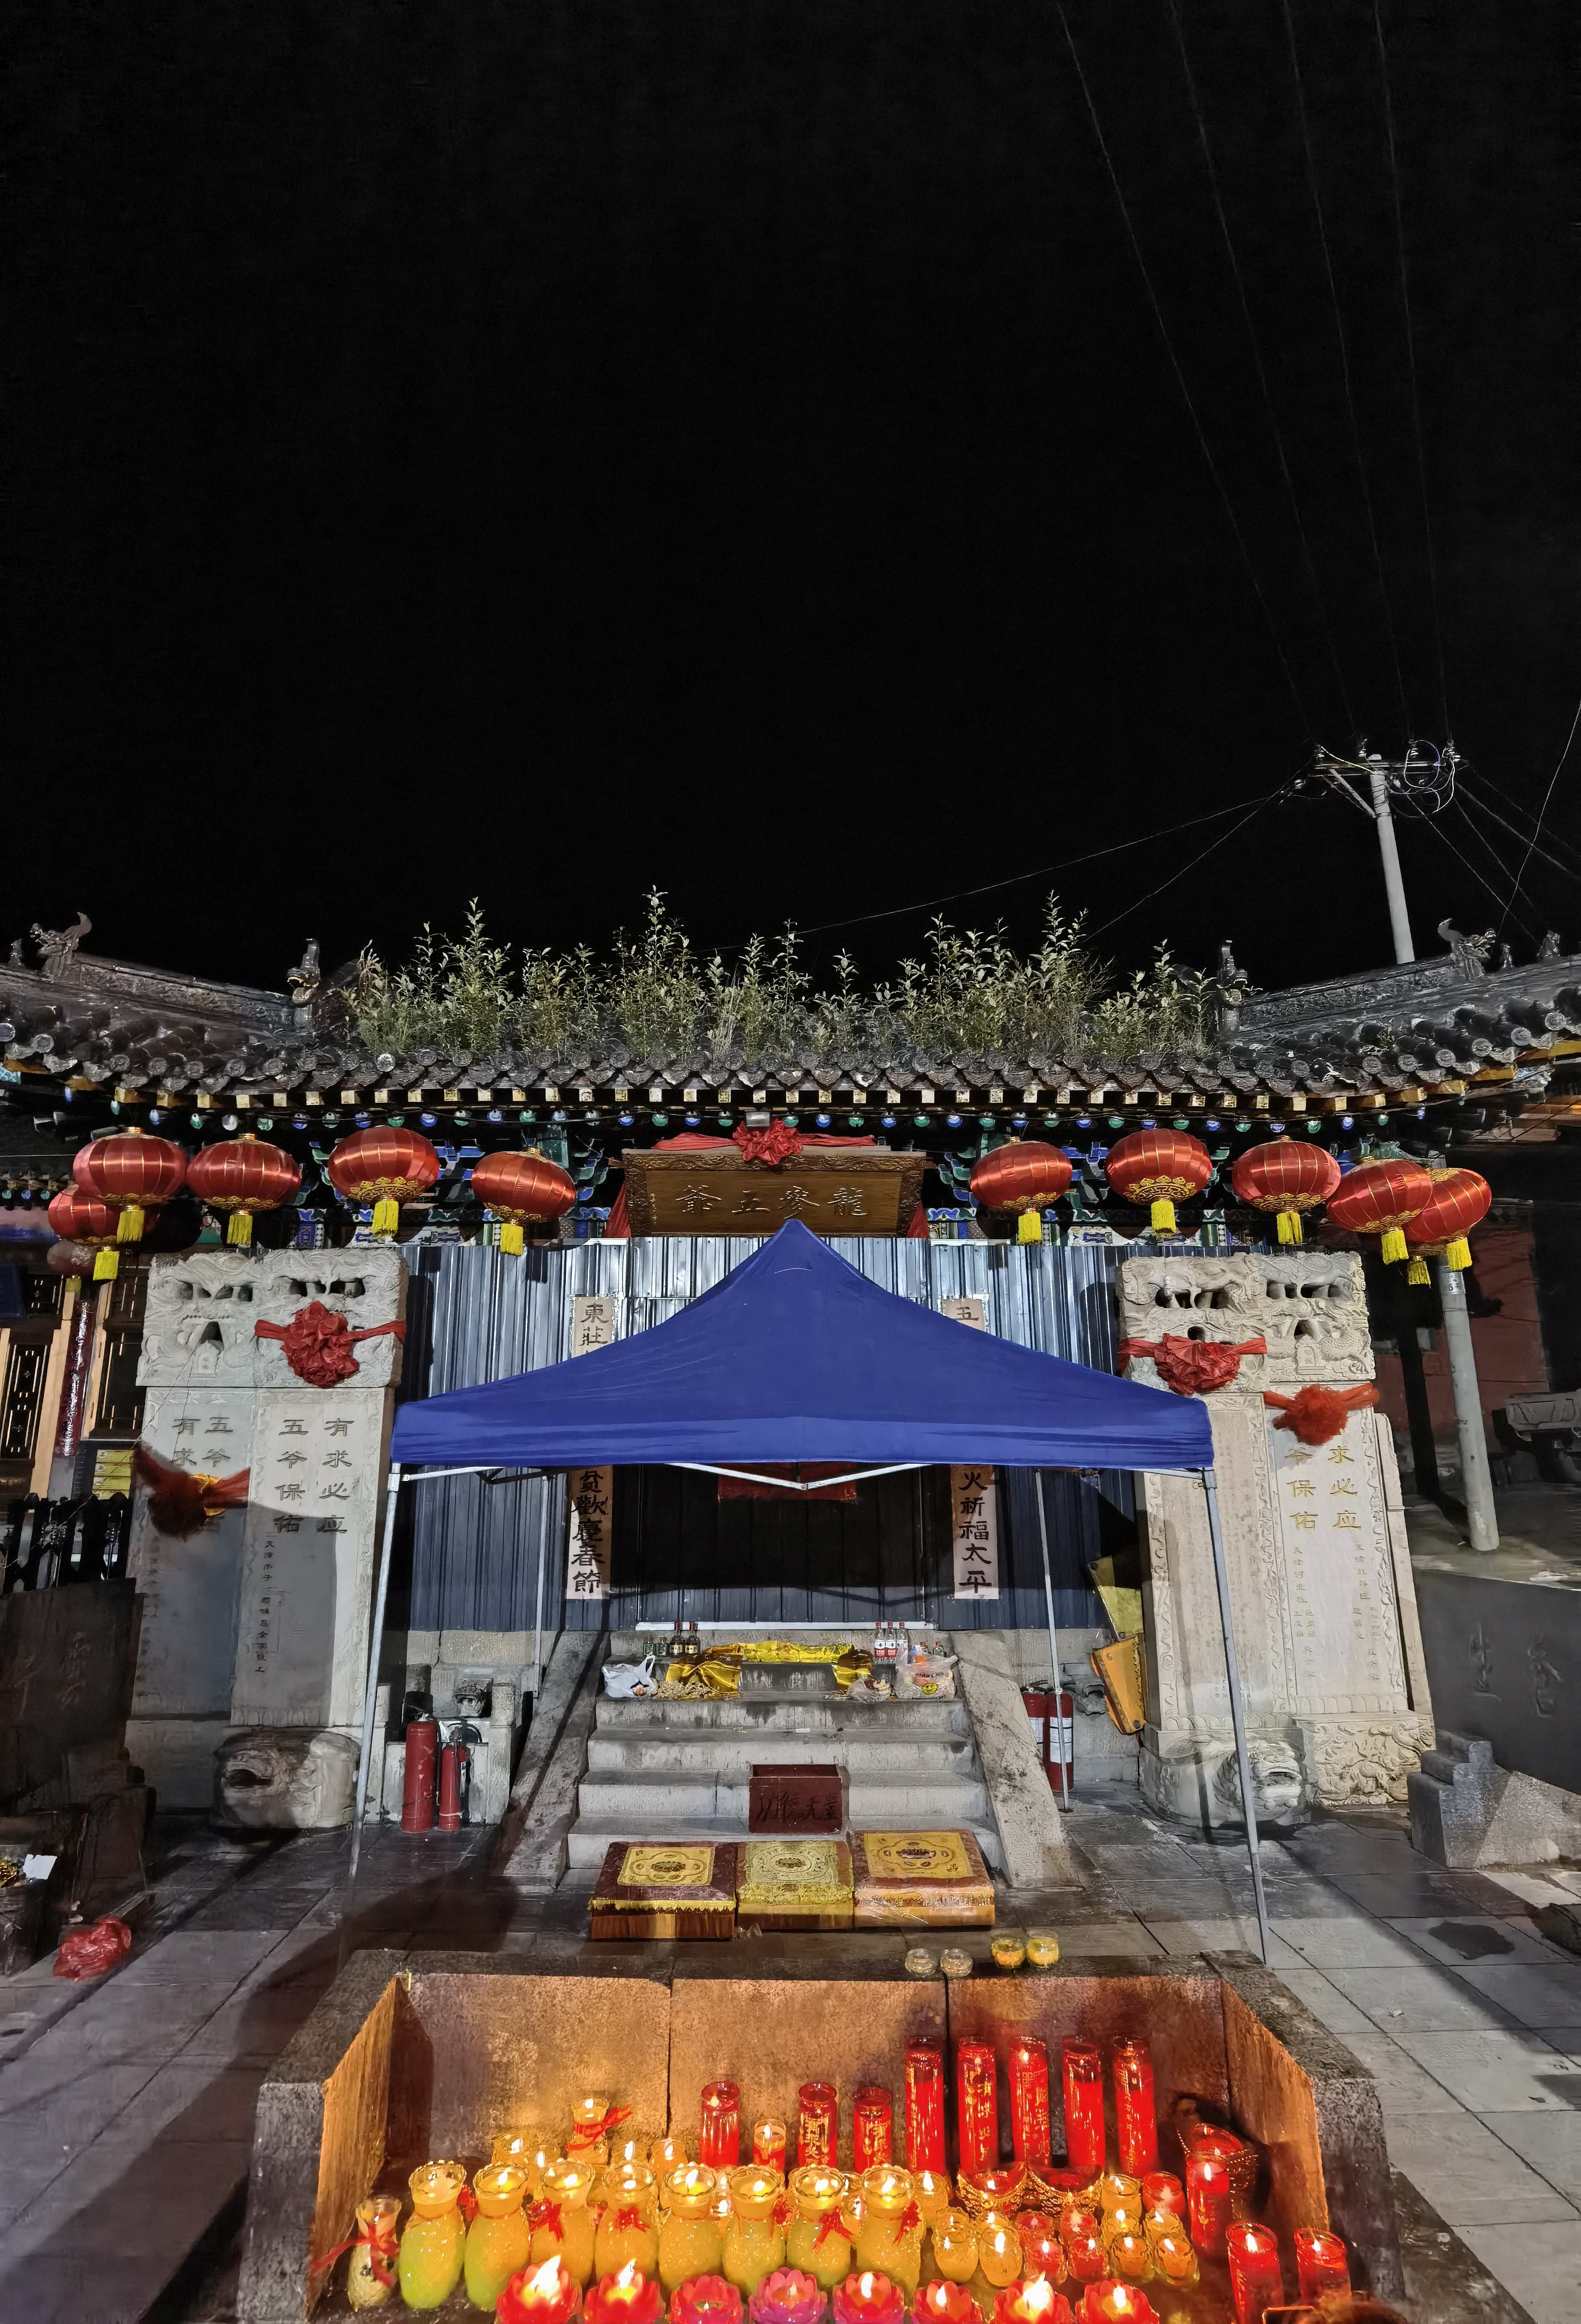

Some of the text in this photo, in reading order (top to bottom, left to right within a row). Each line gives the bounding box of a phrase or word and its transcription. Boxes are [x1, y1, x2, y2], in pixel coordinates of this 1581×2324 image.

[578, 1302, 609, 1353] 東莊
[274, 1419, 309, 1533] 五爷保佑
[317, 1418, 355, 1534] 有求必应
[1285, 1447, 1319, 1531] 爷保佑
[1328, 1446, 1362, 1531] 求必应
[958, 1471, 992, 1593] 火祈福太平
